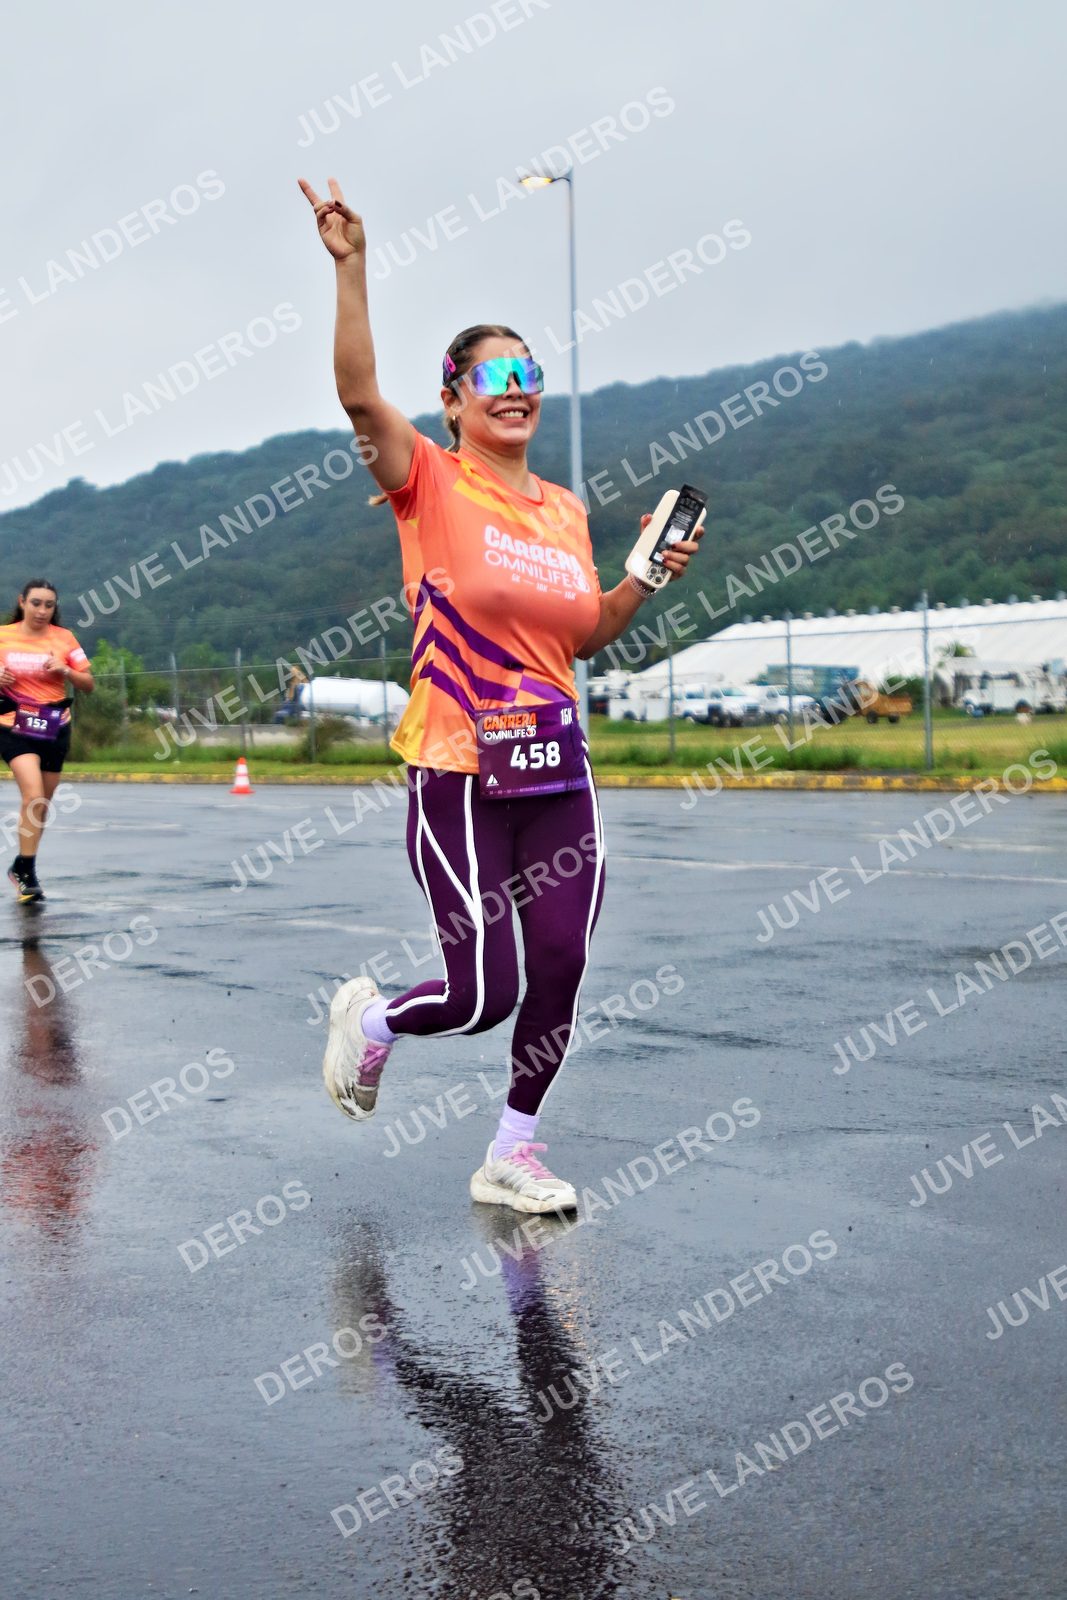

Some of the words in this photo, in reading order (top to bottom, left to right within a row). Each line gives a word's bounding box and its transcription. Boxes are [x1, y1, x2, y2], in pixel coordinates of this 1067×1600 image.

[484, 549, 574, 588] OMNILIFE
[26, 716, 48, 730] 152
[483, 712, 537, 730] CARRERA
[560, 707, 573, 726] 15K
[484, 728, 526, 740] OMNILIFE
[509, 740, 561, 770] 458
